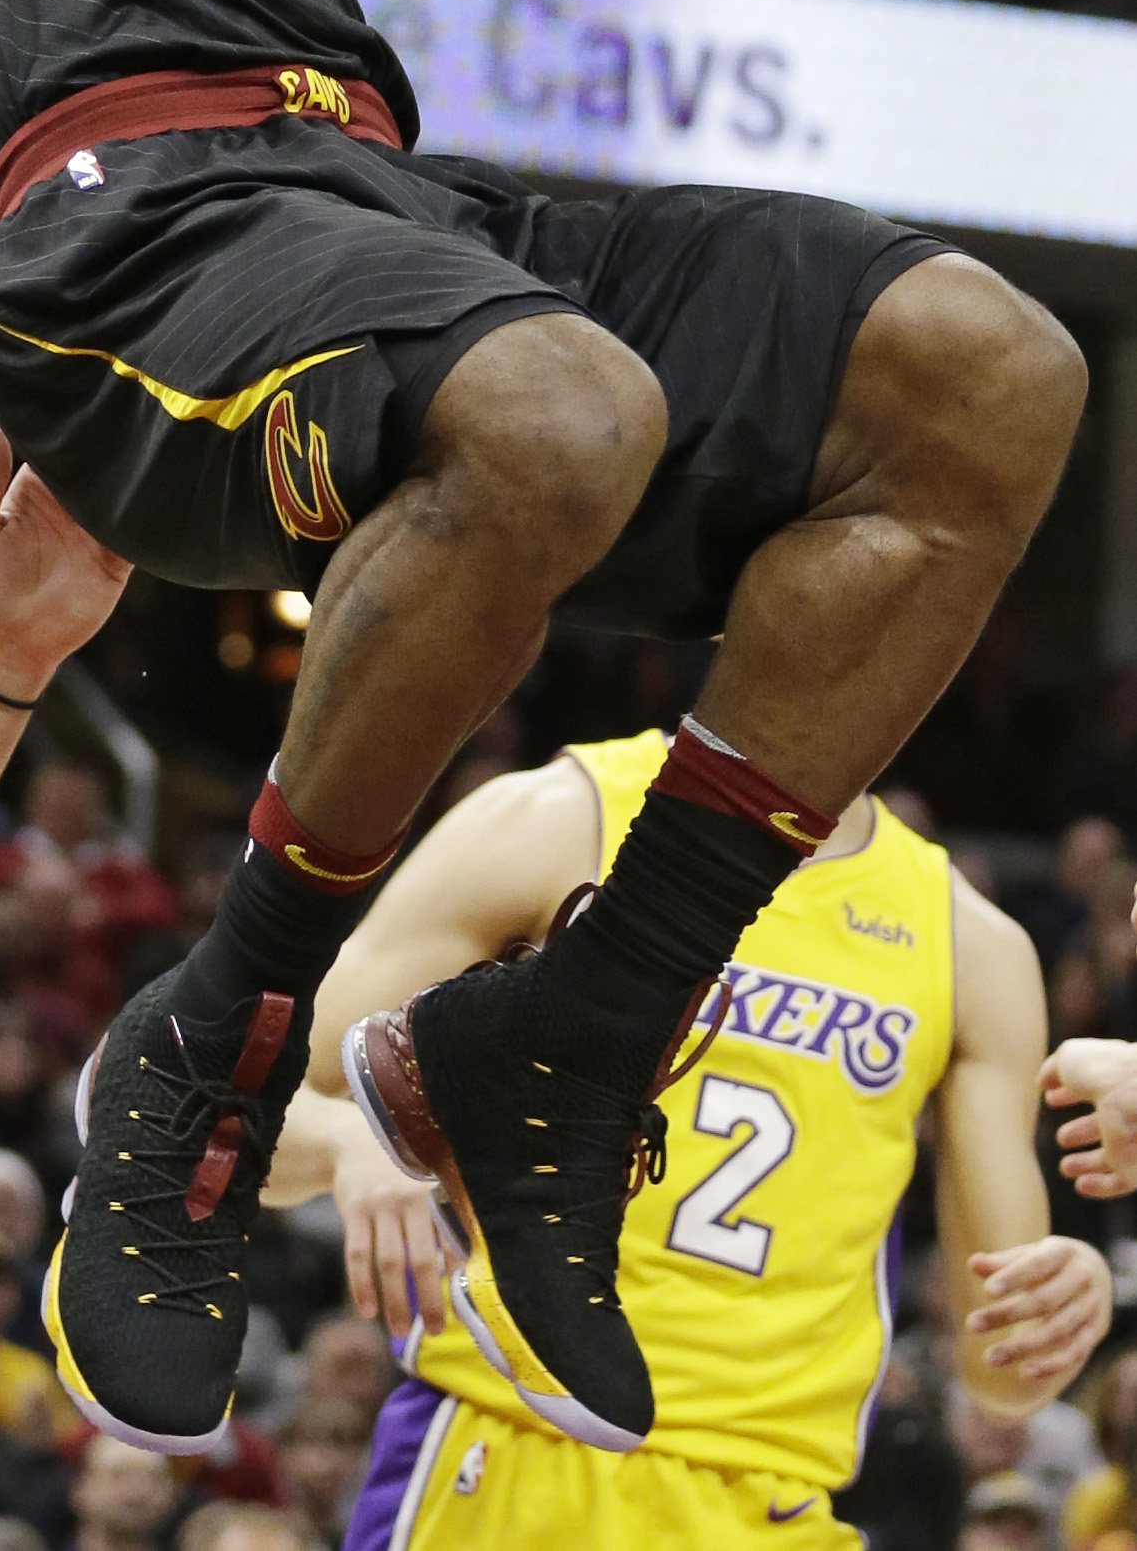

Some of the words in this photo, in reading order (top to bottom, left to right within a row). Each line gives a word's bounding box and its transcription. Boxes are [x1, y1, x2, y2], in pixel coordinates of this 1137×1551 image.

[278, 67, 351, 124] CAVS
[842, 900, 914, 948] wish
[691, 962, 918, 1097] KERS
[666, 1072, 795, 1278] 2
